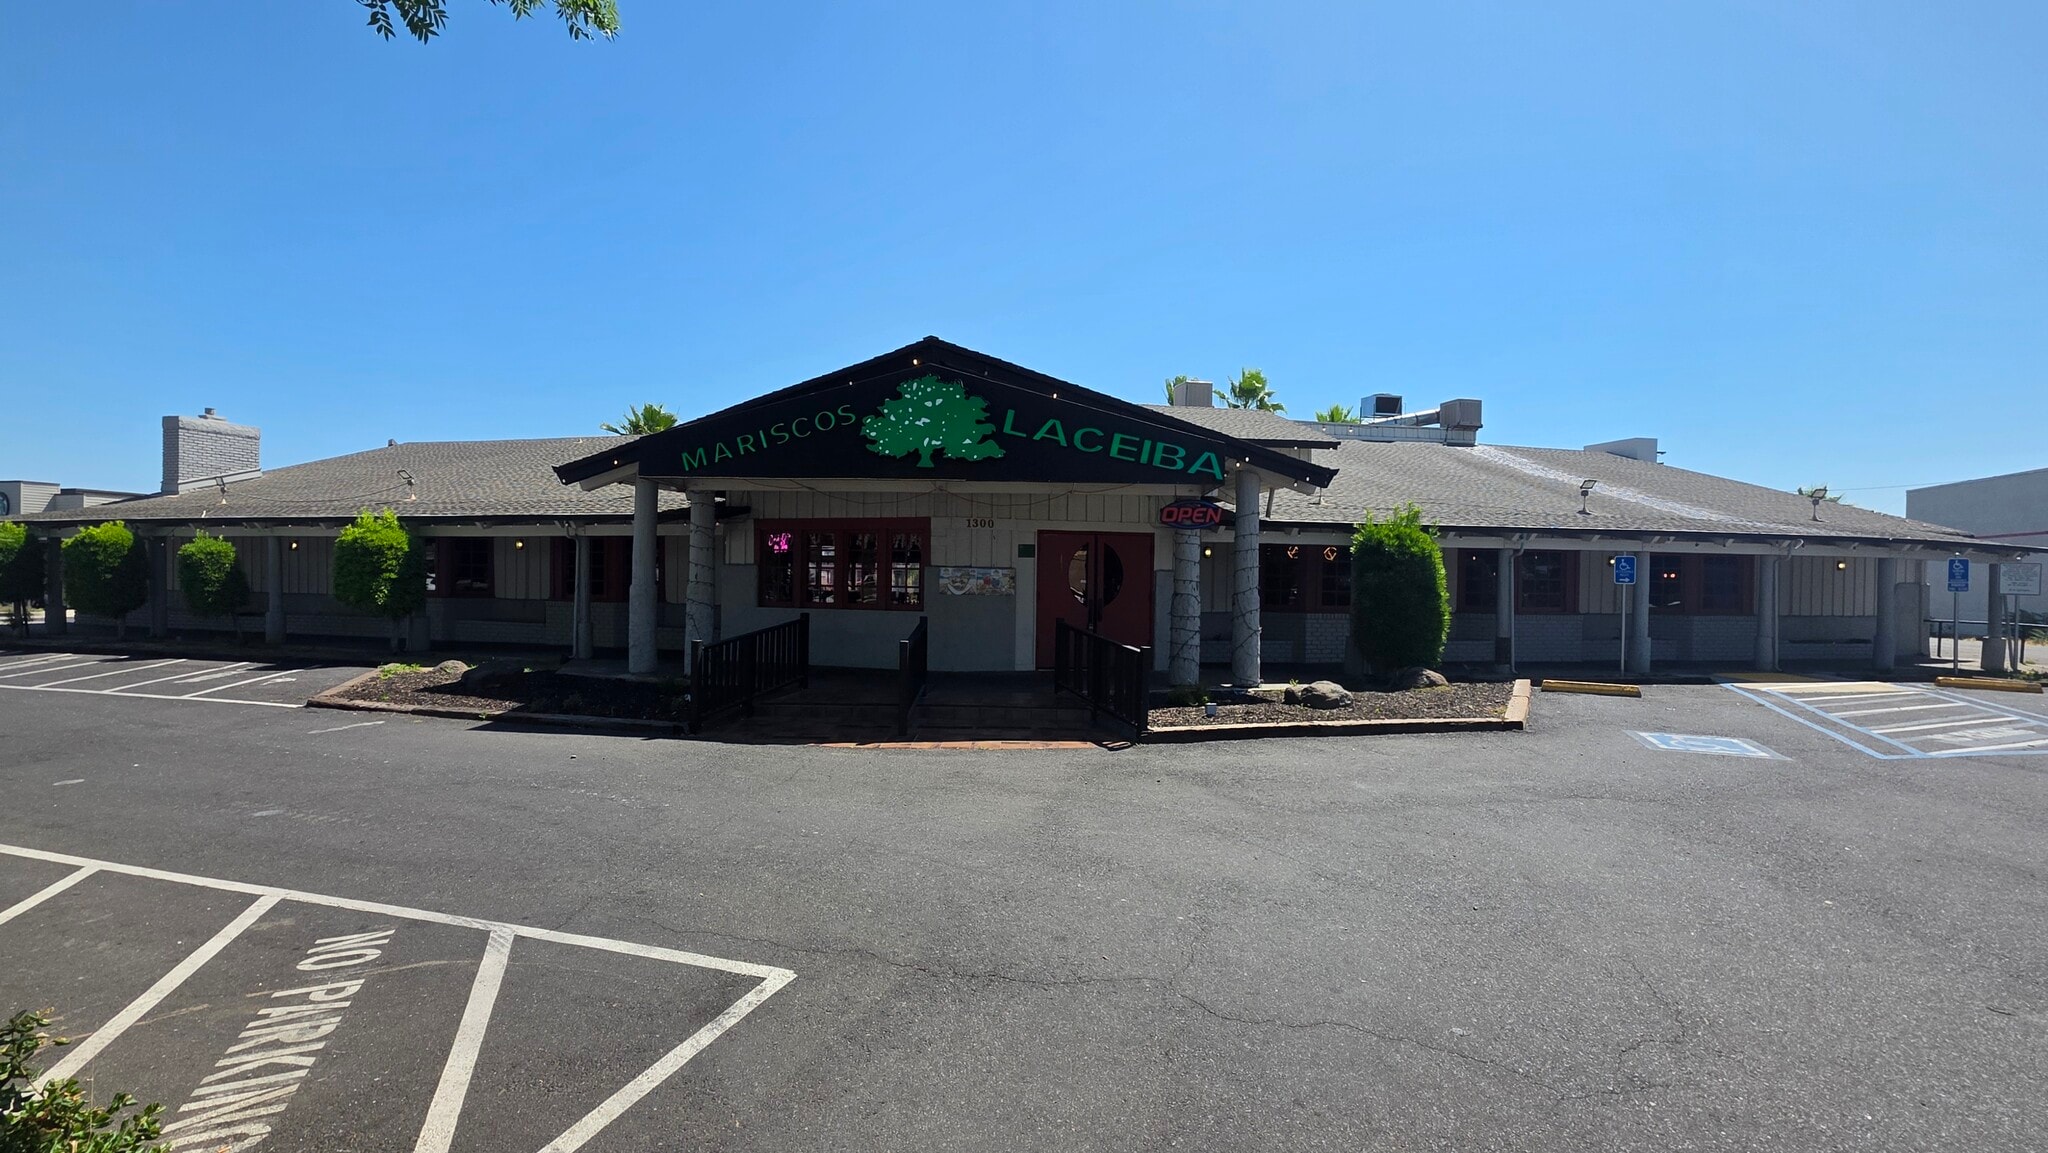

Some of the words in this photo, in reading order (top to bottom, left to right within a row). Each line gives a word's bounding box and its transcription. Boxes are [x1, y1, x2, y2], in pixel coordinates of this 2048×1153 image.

[681, 404, 857, 472] MARISCOS
[1002, 409, 1224, 480] LACEIBA
[966, 518, 995, 529] 1300
[1161, 506, 1222, 523] OPEN
[296, 929, 396, 971] NO
